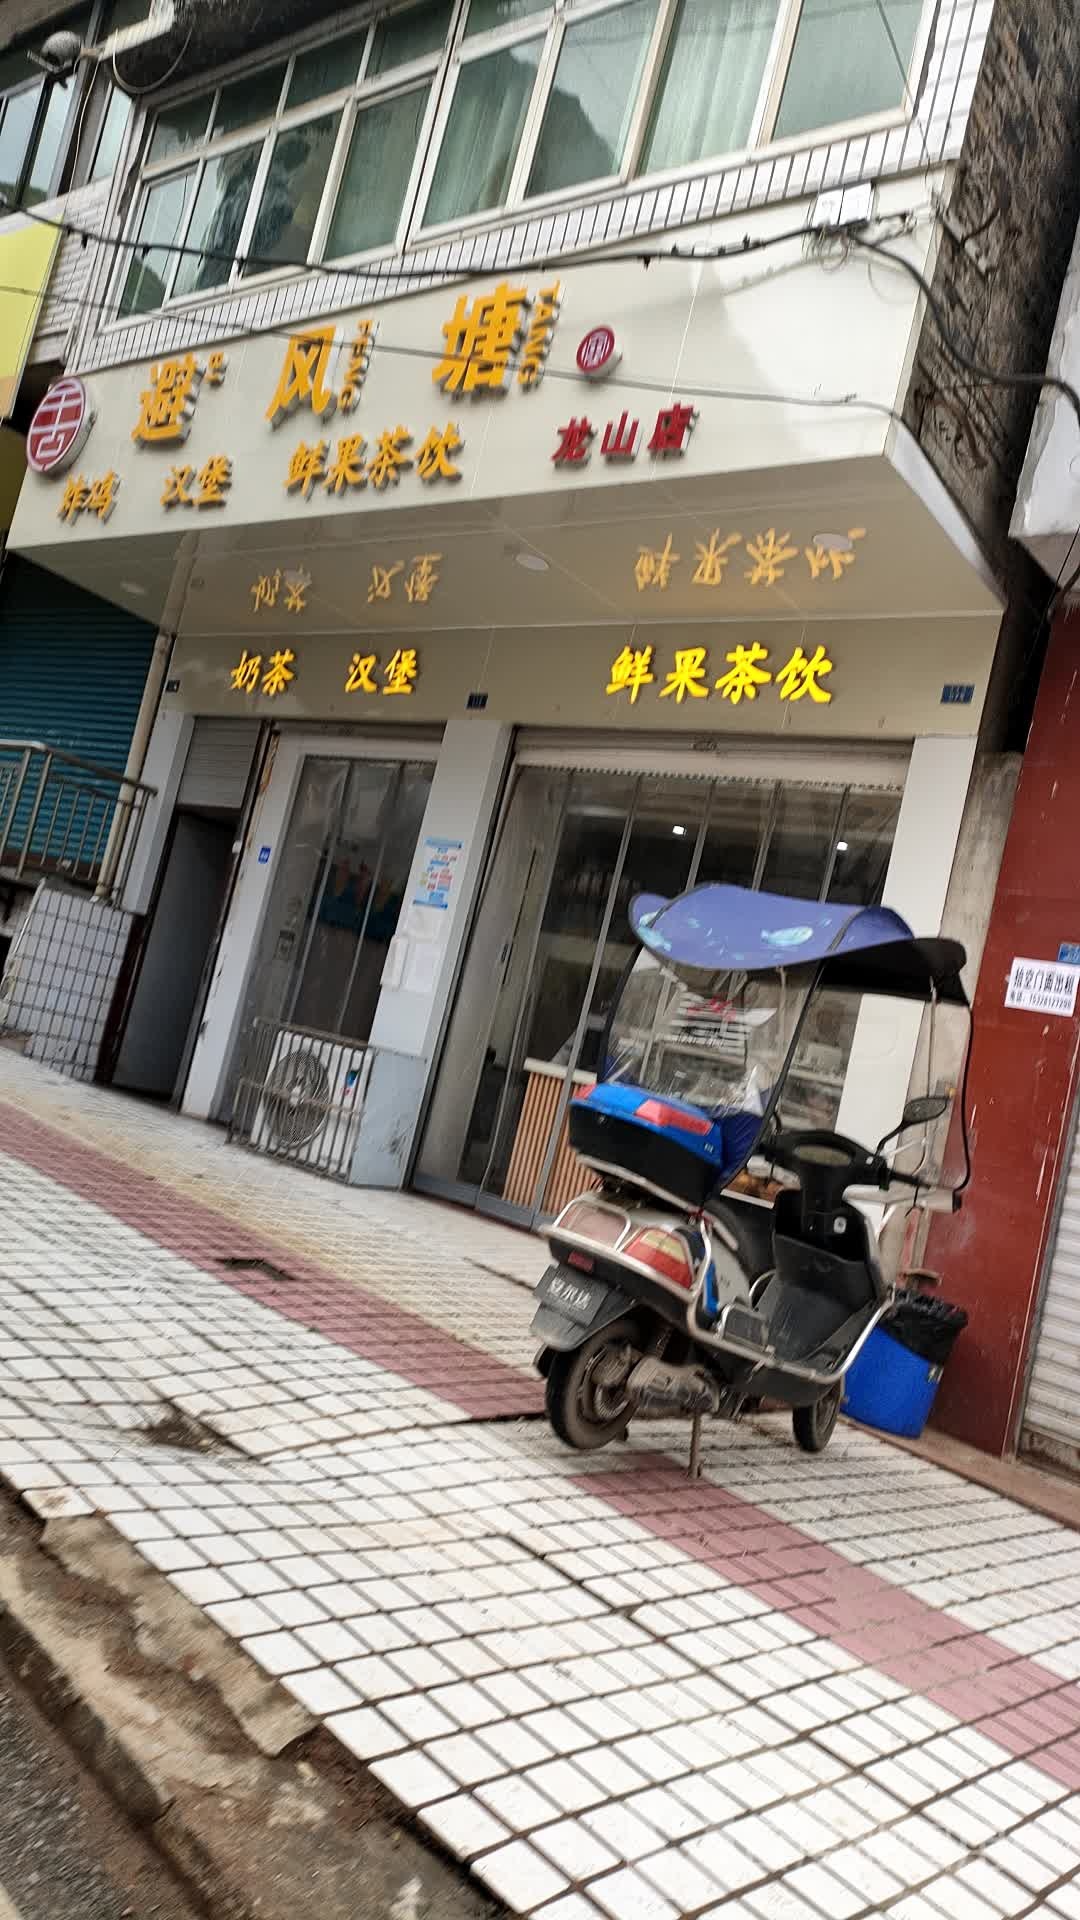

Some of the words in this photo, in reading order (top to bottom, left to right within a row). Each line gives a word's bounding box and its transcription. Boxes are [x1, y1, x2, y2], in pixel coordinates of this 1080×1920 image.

[517, 280, 560, 384] TANG
[59, 468, 115, 522] 炸鸡
[160, 454, 227, 505] 汉堡
[283, 422, 461, 497] 鲜果茶饮
[550, 401, 694, 461] 龙山店
[229, 648, 296, 697] 奶茶
[344, 648, 417, 695] 汉堡
[605, 641, 834, 705] 鲜果茶饮
